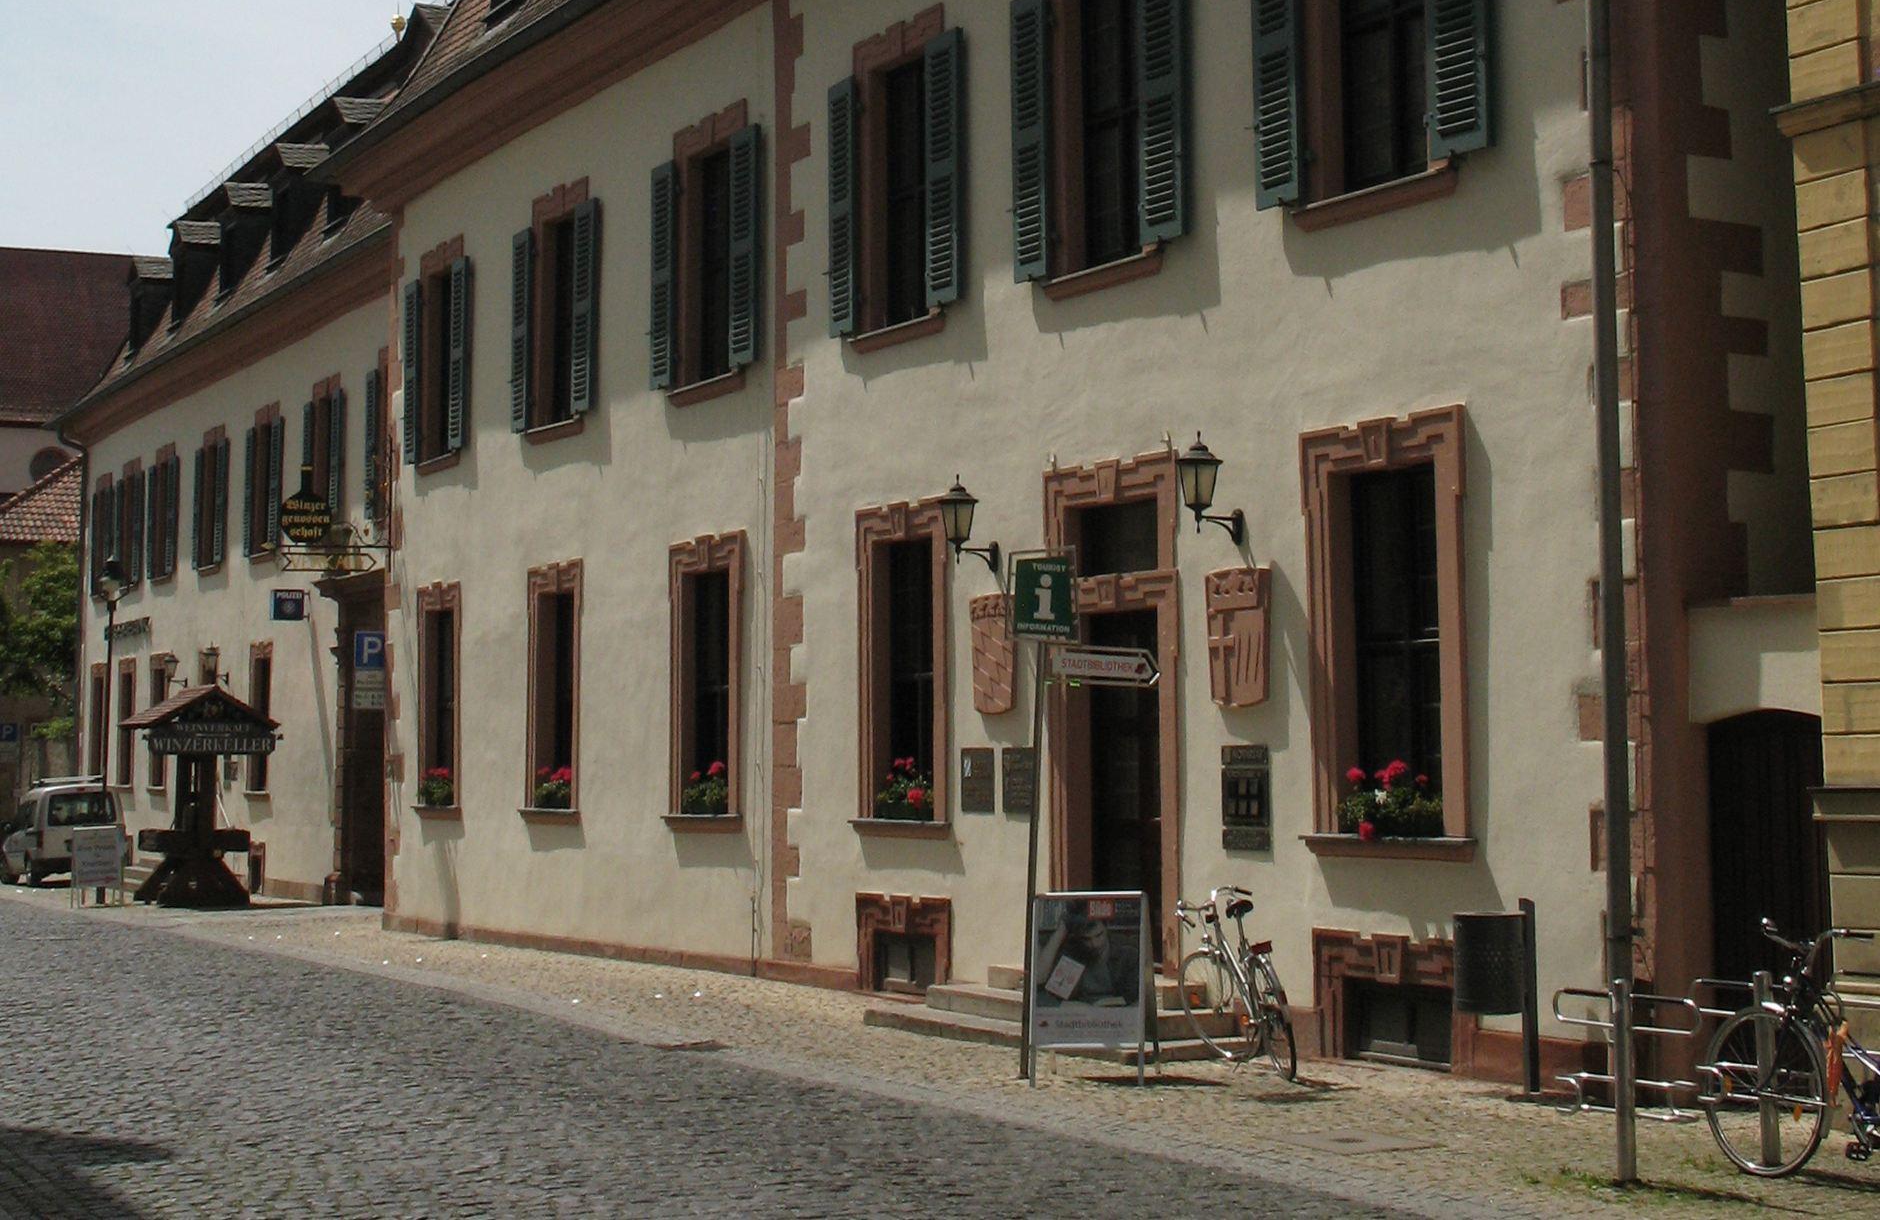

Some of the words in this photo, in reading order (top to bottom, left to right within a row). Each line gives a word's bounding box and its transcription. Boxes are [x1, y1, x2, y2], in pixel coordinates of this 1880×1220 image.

[282, 515, 330, 526] genossen
[1032, 562, 1067, 573] TOURIST
[276, 591, 303, 600] POLIZEI
[1016, 622, 1071, 633] INFORMATION
[362, 636, 382, 664] P
[1061, 658, 1133, 671] STADTBIBLIOTHEK
[153, 738, 271, 752] WINZERKELLER
